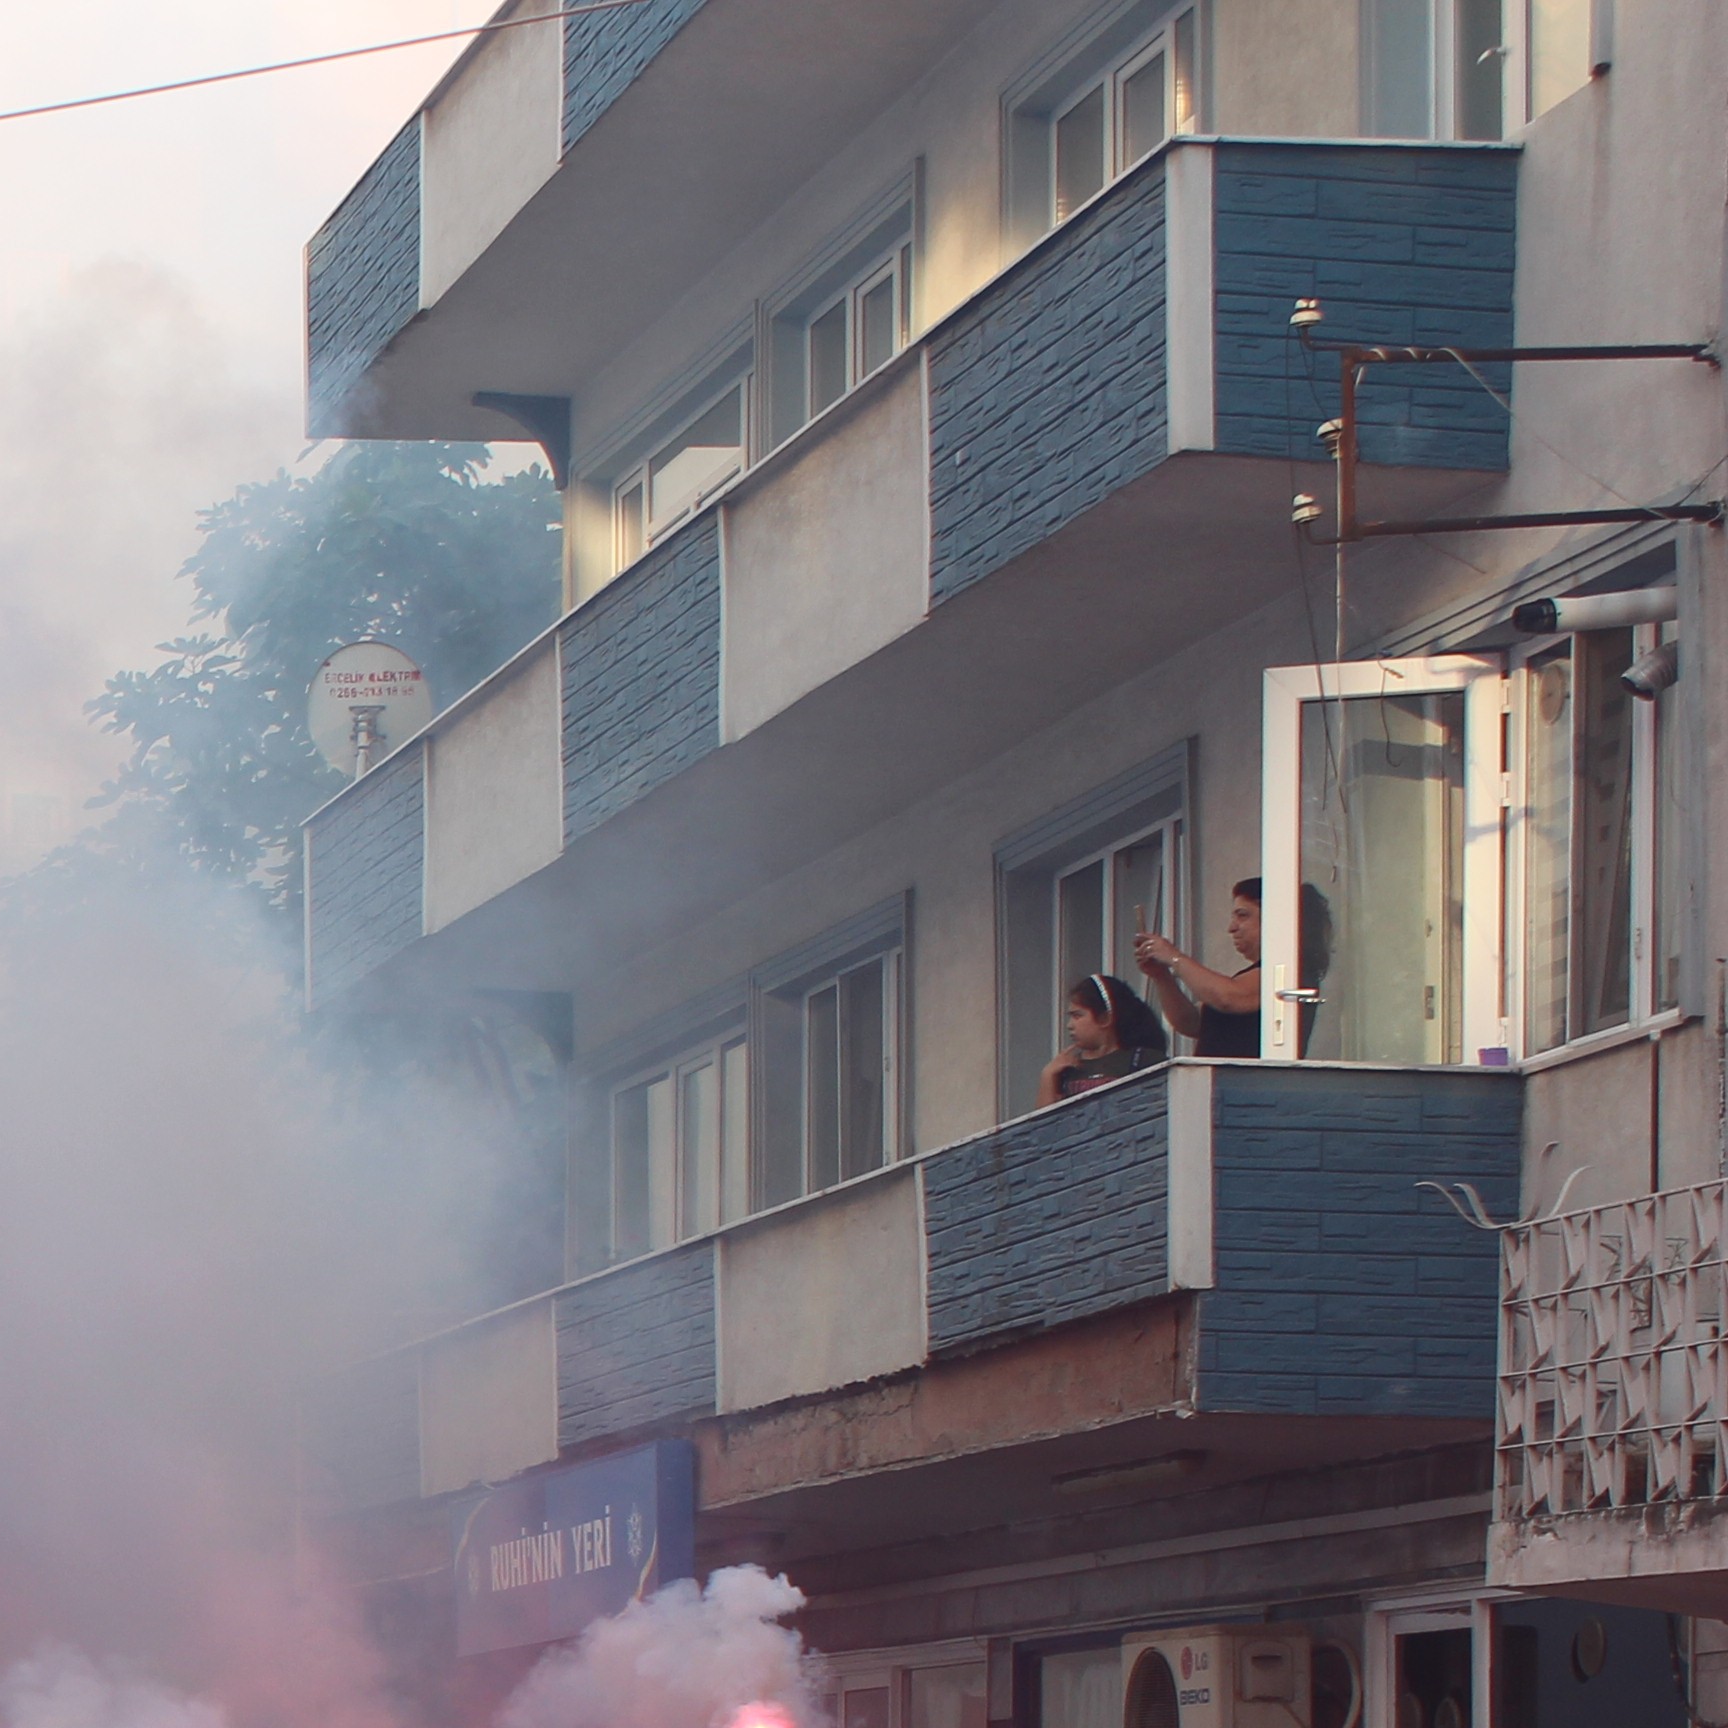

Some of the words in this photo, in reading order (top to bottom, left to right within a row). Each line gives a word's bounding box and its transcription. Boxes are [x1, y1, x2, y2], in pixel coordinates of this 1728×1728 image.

[490, 1520, 563, 1592] RUHİ'NİN
[571, 1504, 612, 1575] YERİ
[1180, 1688, 1211, 1705] BEKO
